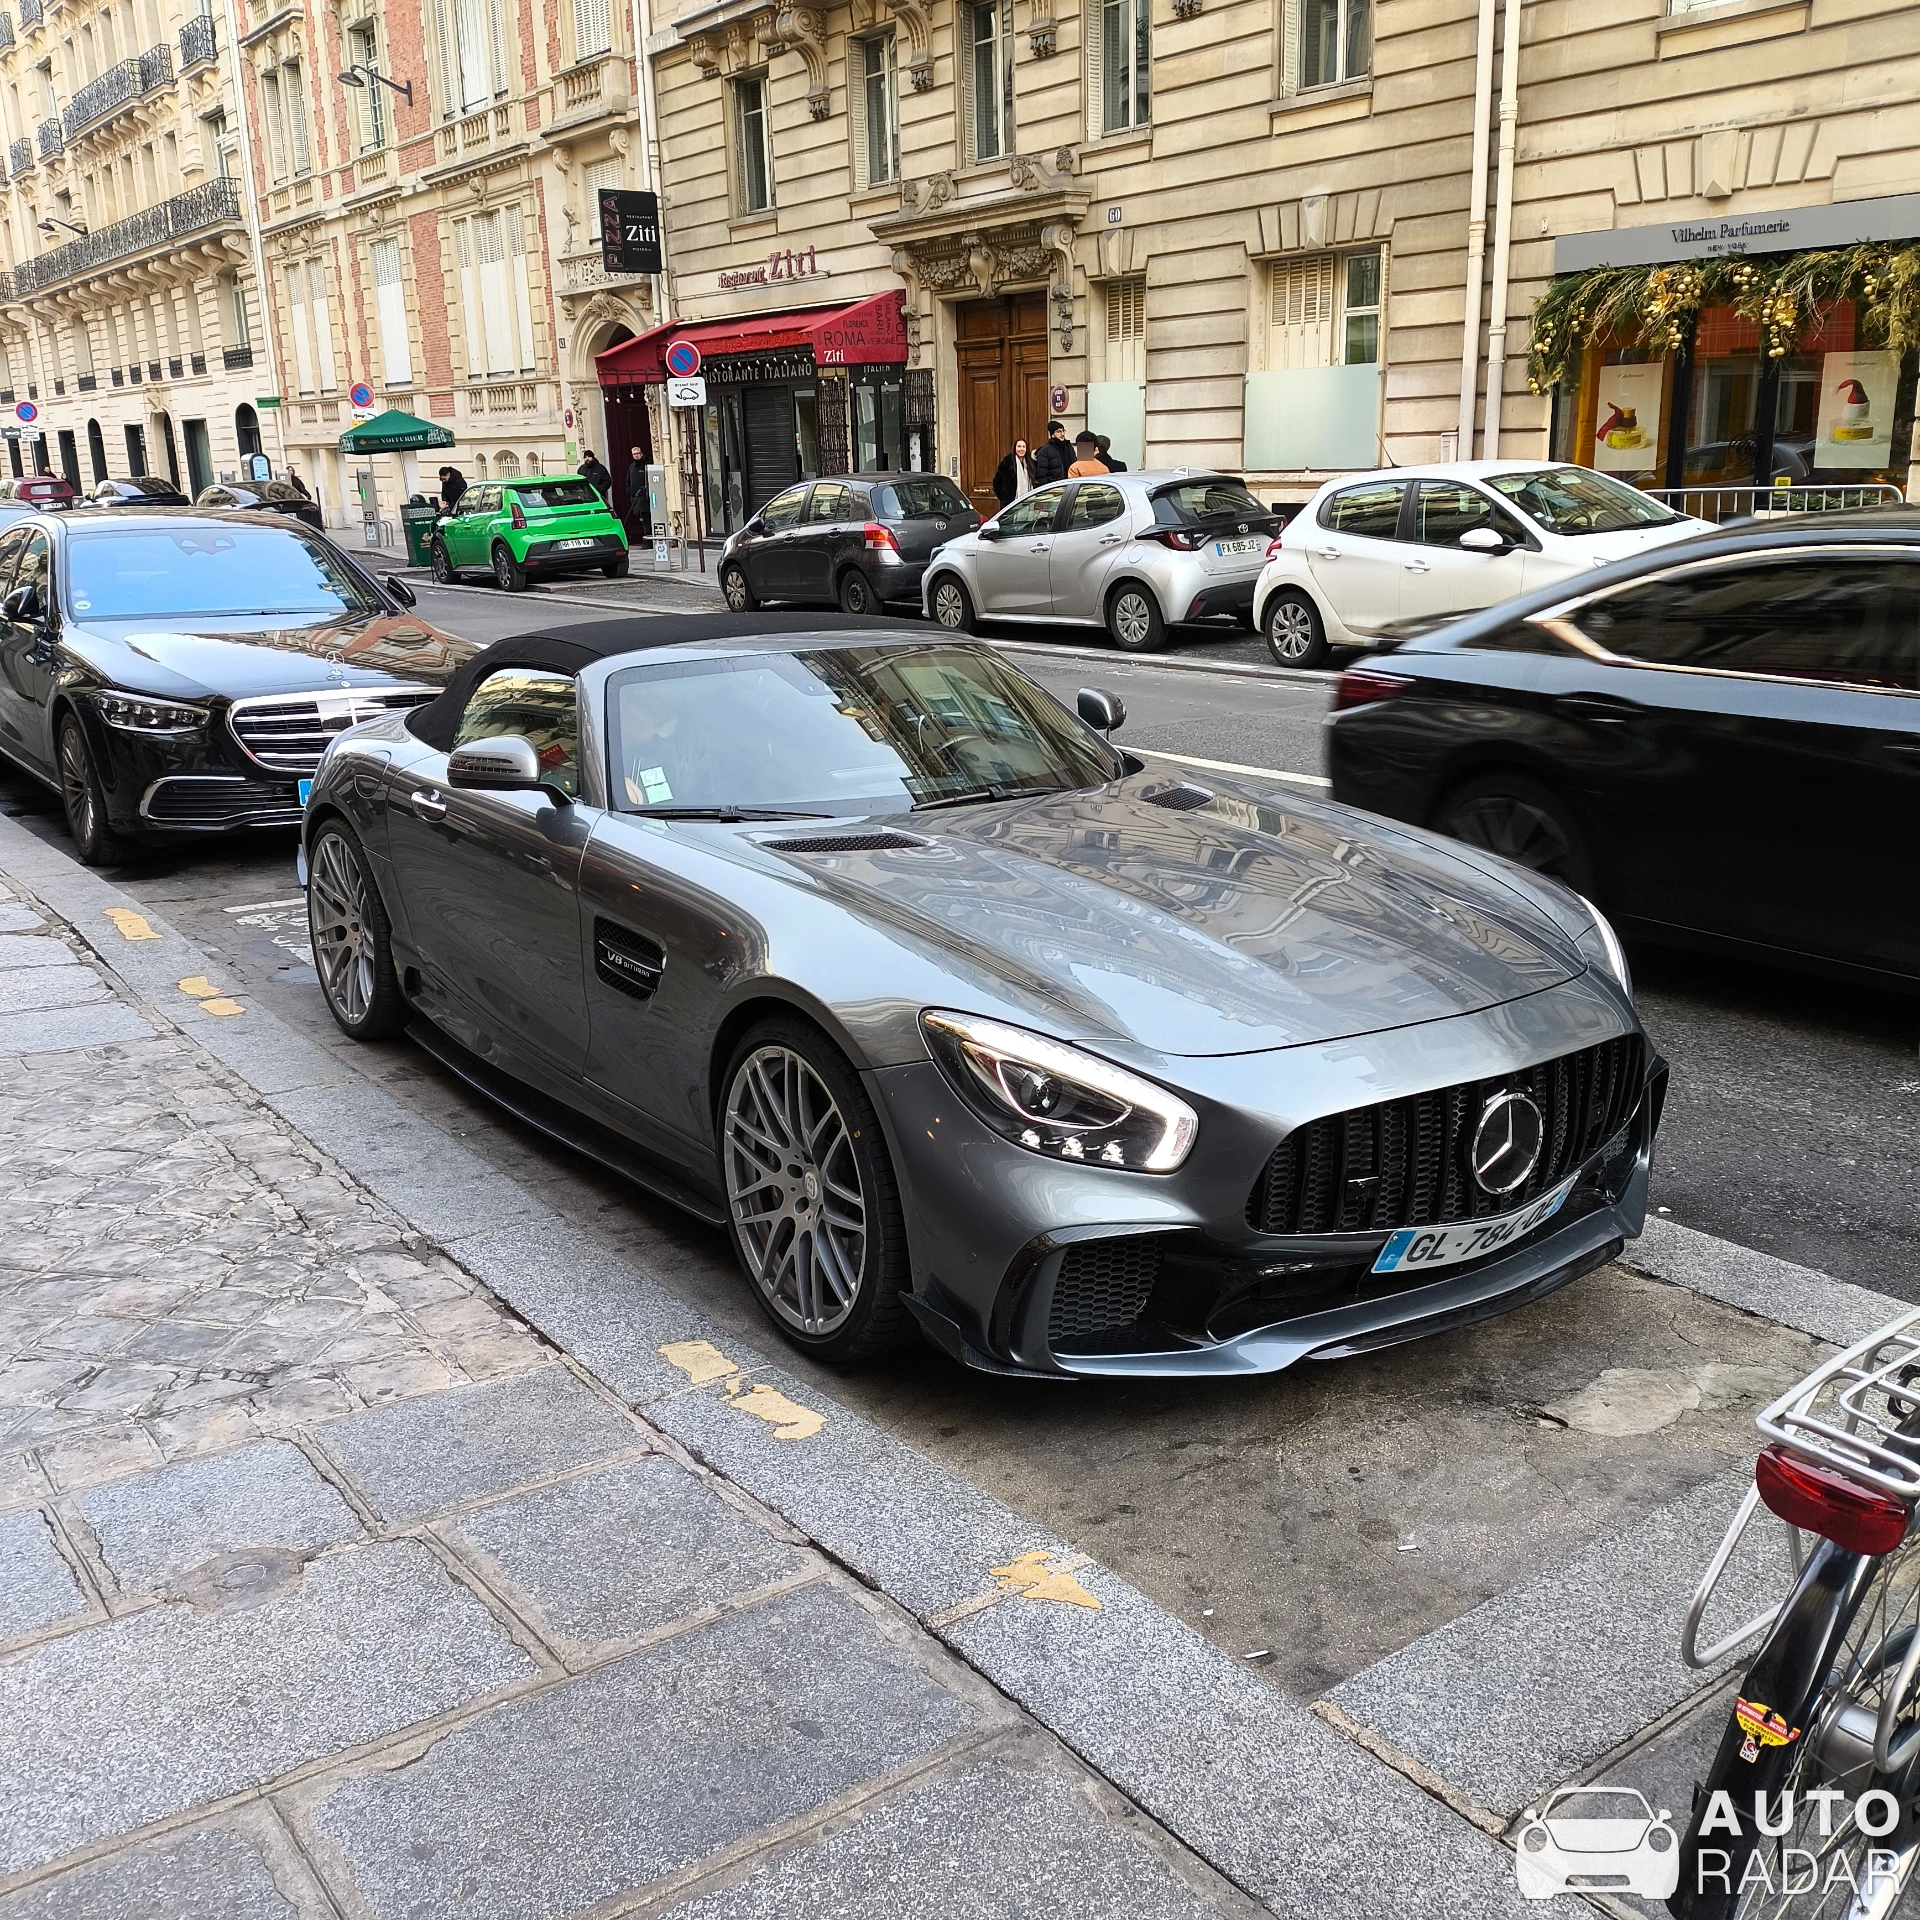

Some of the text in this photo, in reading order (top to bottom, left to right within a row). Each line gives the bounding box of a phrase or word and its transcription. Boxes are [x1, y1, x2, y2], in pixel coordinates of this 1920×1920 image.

[1109, 208, 1121, 222] 60
[603, 195, 623, 268] PIZZA
[625, 224, 657, 242] Ziti
[1671, 219, 1790, 243] Vilhelm Parfumerie
[1707, 241, 1748, 252] NEW YORK
[767, 245, 817, 280] Ziti
[843, 320, 869, 328] FLORENCE
[875, 304, 884, 330] BARI
[823, 331, 866, 346] ROMA
[867, 337, 896, 345] VERONE
[823, 348, 845, 363] Ziti
[703, 362, 812, 384] RISTORANTE ITALIANO
[381, 434, 424, 444] VOITURIER
[607, 950, 650, 978] V8 BITURBO
